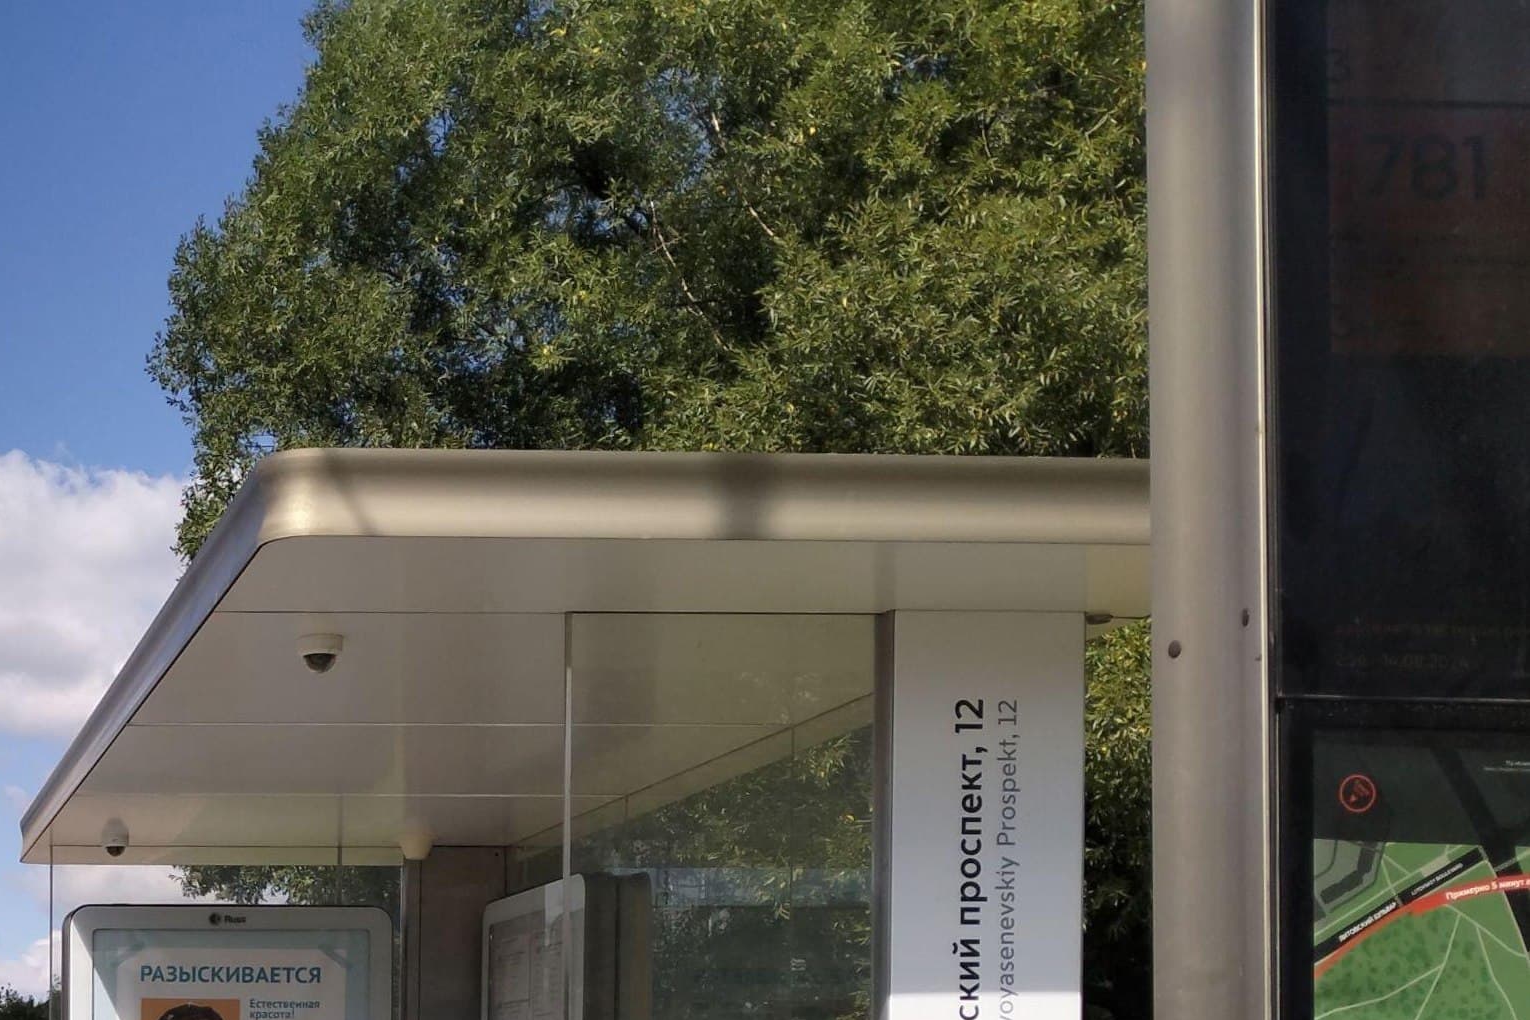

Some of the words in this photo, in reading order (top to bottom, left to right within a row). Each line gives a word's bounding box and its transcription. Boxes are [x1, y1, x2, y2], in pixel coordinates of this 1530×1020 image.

[955, 698, 984, 734] 12
[997, 699, 1018, 726] 12
[996, 734, 1021, 846] Prospekt,
[960, 746, 988, 926] проспект,
[1445, 883, 1490, 901] Примерно
[1491, 881, 1498, 891] 5
[139, 964, 322, 984] РАЗЫСКИВАЕТСЯ
[249, 998, 320, 1009] Естественная
[249, 1007, 295, 1020] красота!
